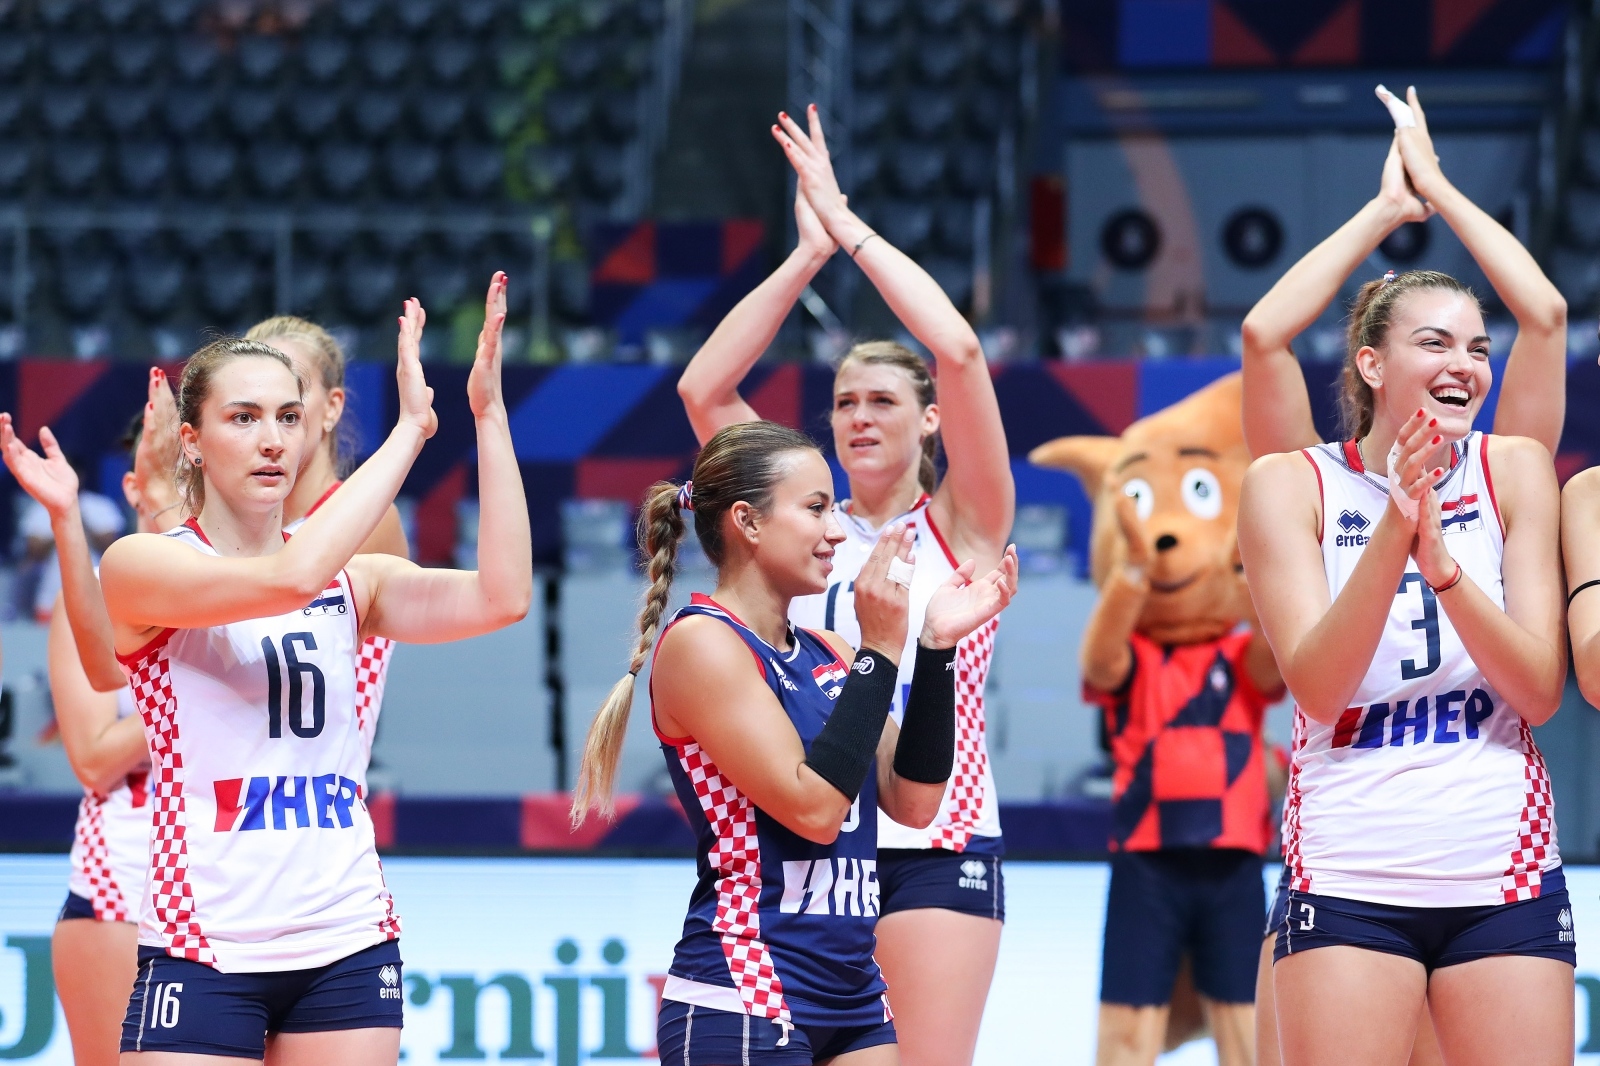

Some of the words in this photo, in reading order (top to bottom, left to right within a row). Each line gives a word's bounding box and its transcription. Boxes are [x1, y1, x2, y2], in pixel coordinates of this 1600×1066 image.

[1396, 572, 1442, 681] 3
[260, 631, 326, 739] 16
[1390, 688, 1494, 747] HEP
[271, 773, 357, 830] HEP
[1300, 902, 1315, 931] 3
[151, 982, 184, 1029] 16
